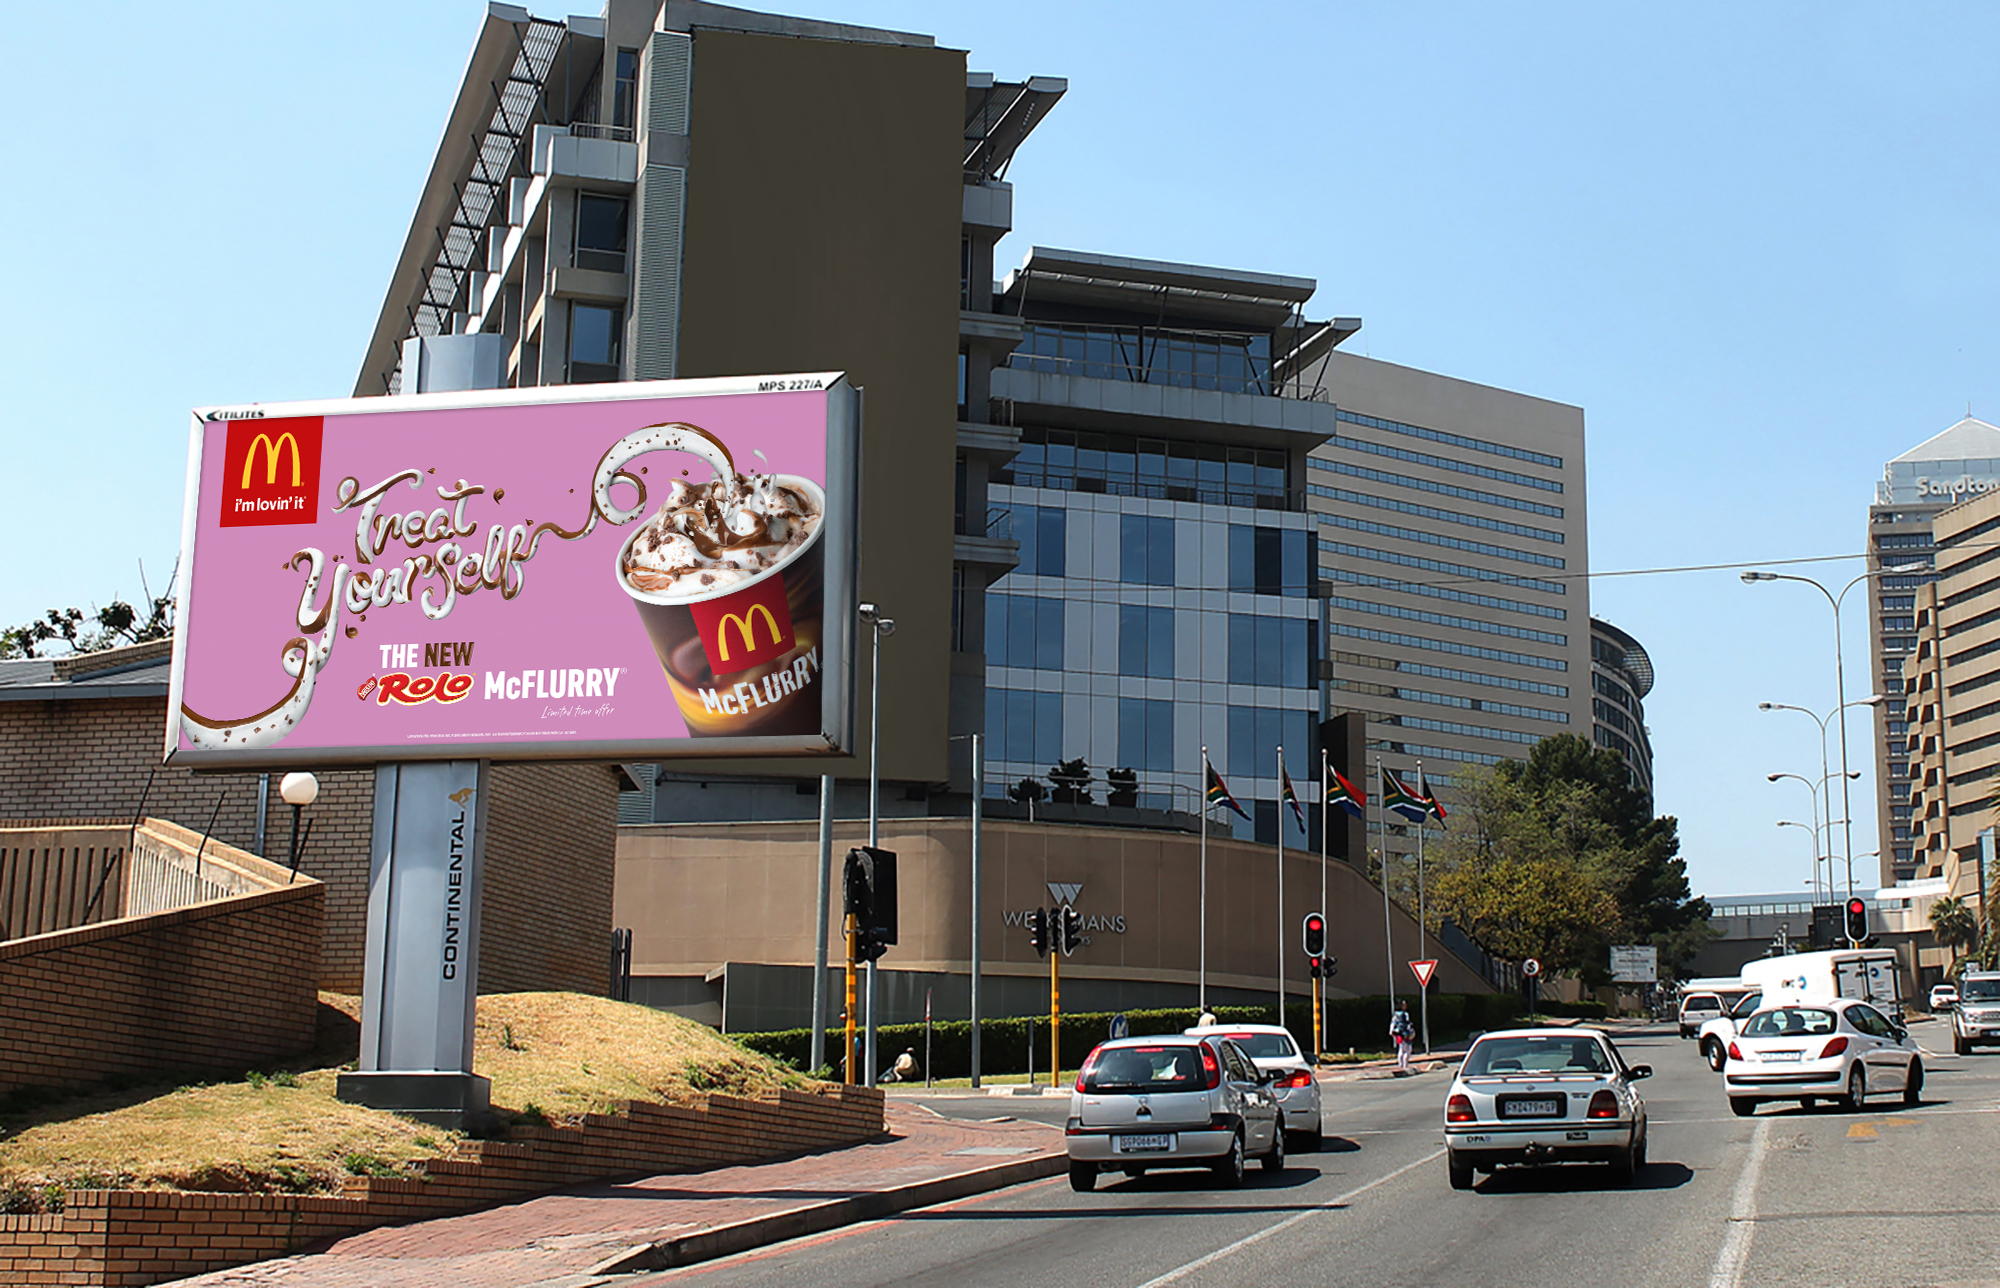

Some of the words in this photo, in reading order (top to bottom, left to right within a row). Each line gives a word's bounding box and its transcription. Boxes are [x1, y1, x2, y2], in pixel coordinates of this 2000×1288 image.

[758, 381, 785, 391] MPS
[789, 379, 822, 390] 227/A
[234, 498, 255, 512] i'm
[256, 496, 293, 511] lovin'
[294, 496, 304, 510] it
[331, 469, 485, 564] Treat
[379, 643, 419, 669] THE
[424, 642, 475, 667] NEW
[541, 705, 574, 719] Limited
[574, 704, 592, 718] time
[594, 703, 616, 717] offer
[443, 811, 465, 981] CONTINENTAL
